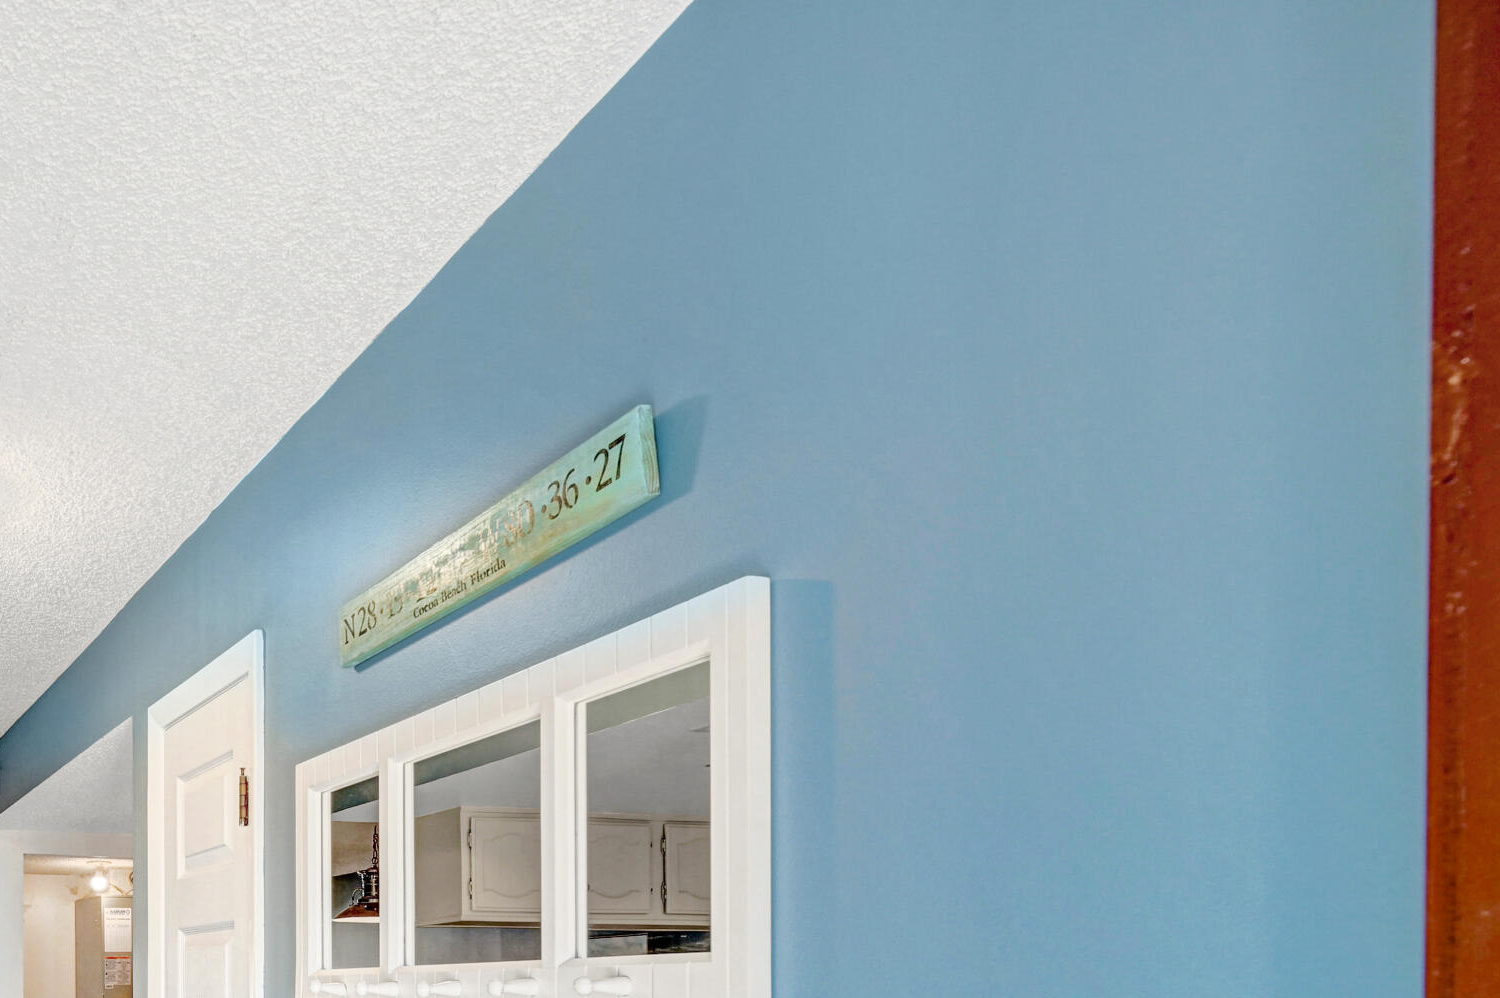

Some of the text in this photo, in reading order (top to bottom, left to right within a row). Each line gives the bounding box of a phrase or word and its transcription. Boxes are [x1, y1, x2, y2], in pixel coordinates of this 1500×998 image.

[412, 557, 507, 618] Cocoa Beach Florida
